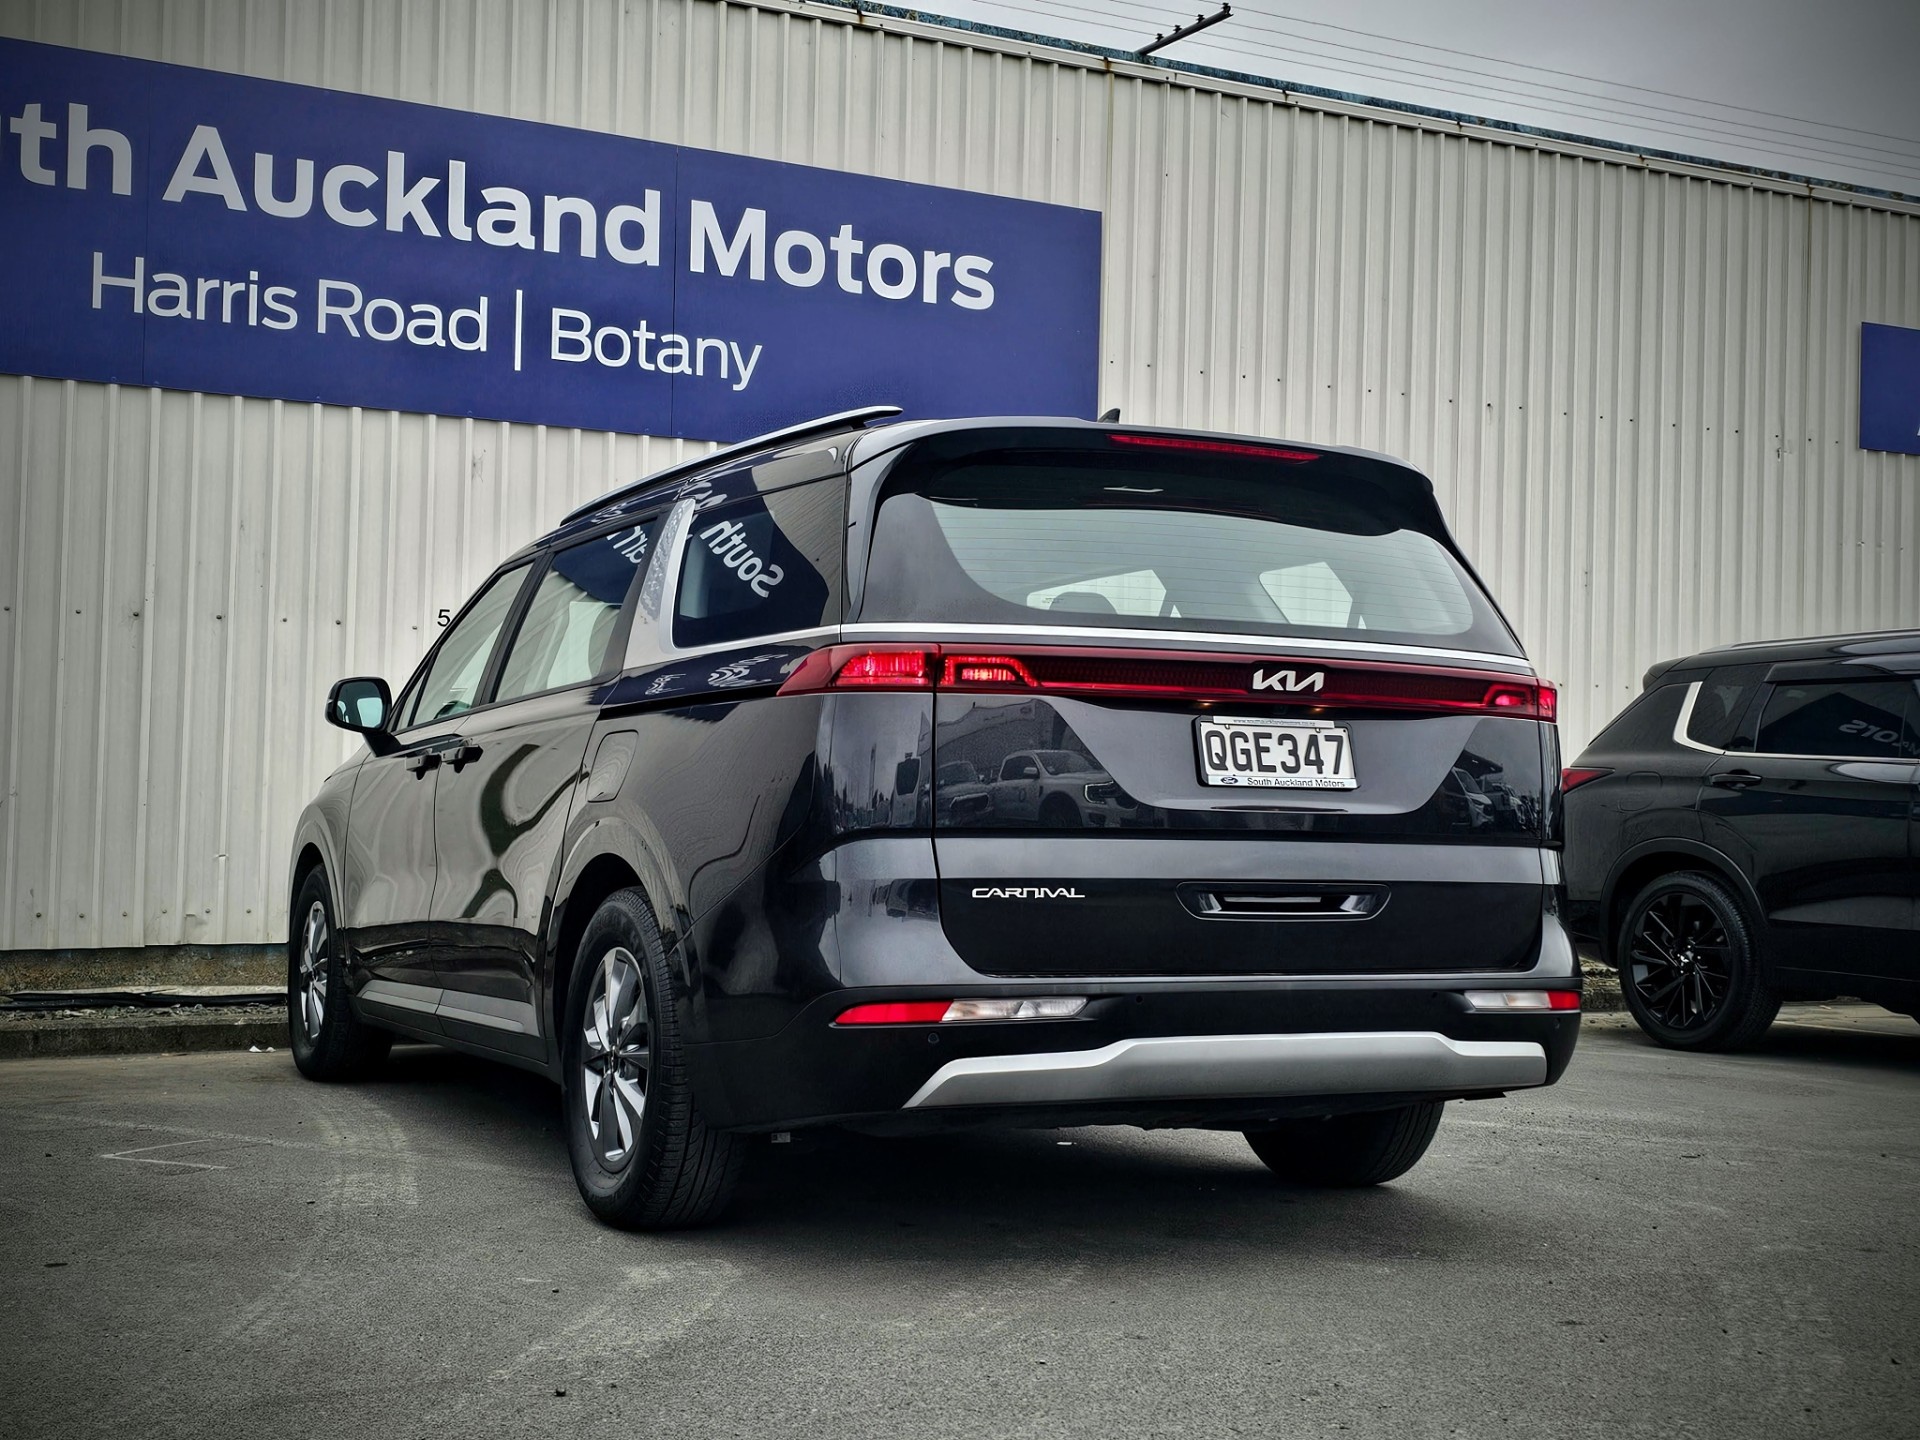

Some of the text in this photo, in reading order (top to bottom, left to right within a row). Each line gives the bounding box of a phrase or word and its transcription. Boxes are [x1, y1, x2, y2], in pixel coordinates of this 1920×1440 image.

[9, 103, 996, 310] th Auckland Motors
[93, 252, 762, 391] Harris Road Botany
[437, 609, 451, 627] 5
[1252, 668, 1325, 692] KIA
[1204, 730, 1344, 775] QGE347
[1246, 777, 1272, 786] South
[1274, 778, 1313, 787] Auckland
[1315, 779, 1345, 788] Motors
[971, 887, 1086, 899] CARNIVAL
